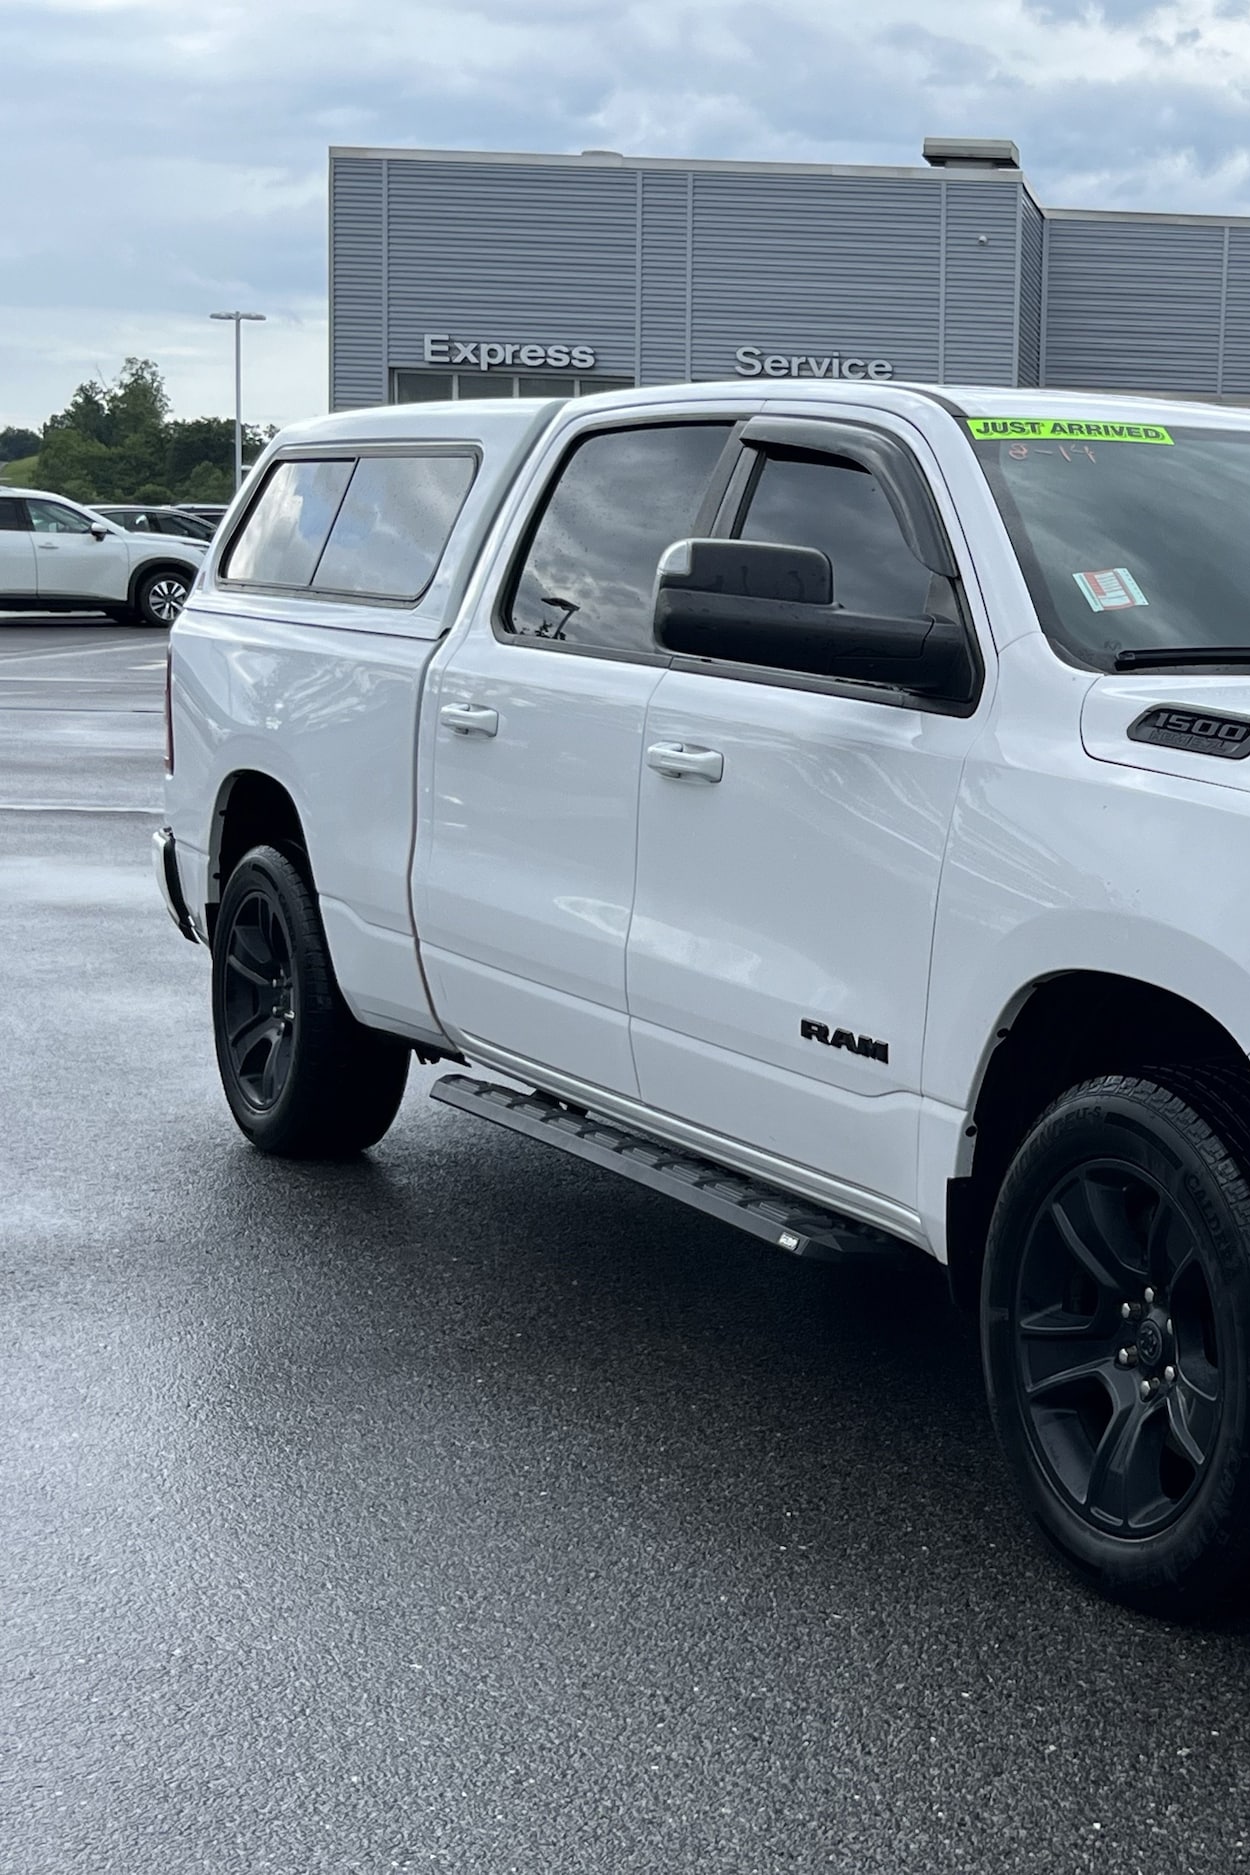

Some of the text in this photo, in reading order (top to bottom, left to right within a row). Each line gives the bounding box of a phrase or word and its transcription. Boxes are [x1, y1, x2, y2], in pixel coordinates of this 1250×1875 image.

[423, 334, 596, 370] Express
[735, 346, 893, 380] Service
[976, 422, 1163, 440] JUST ARRIVED
[1155, 712, 1249, 741] 1500
[801, 1017, 889, 1064] RAM
